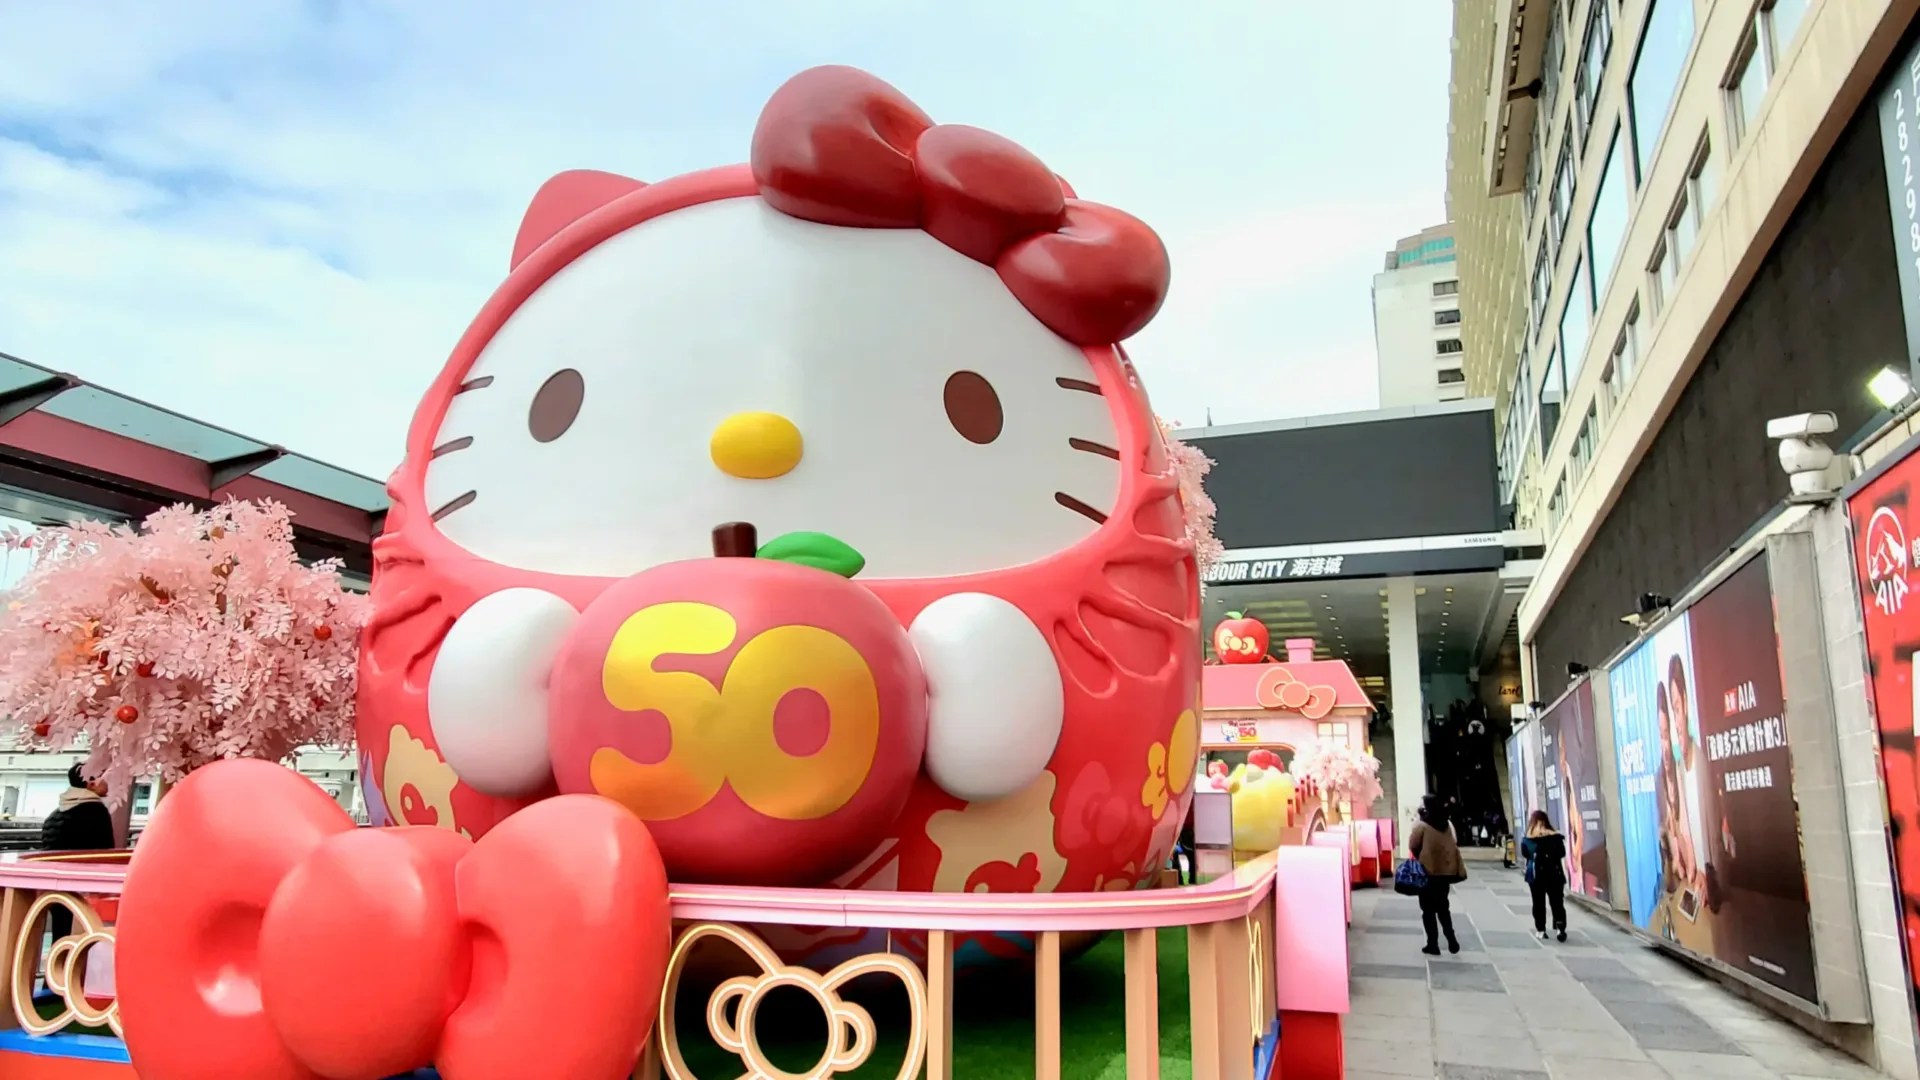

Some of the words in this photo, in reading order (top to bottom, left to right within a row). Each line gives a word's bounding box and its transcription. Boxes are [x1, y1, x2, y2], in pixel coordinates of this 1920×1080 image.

[1463, 536, 1497, 544] SAMSUNG
[1250, 560, 1288, 579] CITY
[1289, 555, 1345, 577] 海港城
[1875, 573, 1909, 616] AIA
[1737, 680, 1757, 713] AIA
